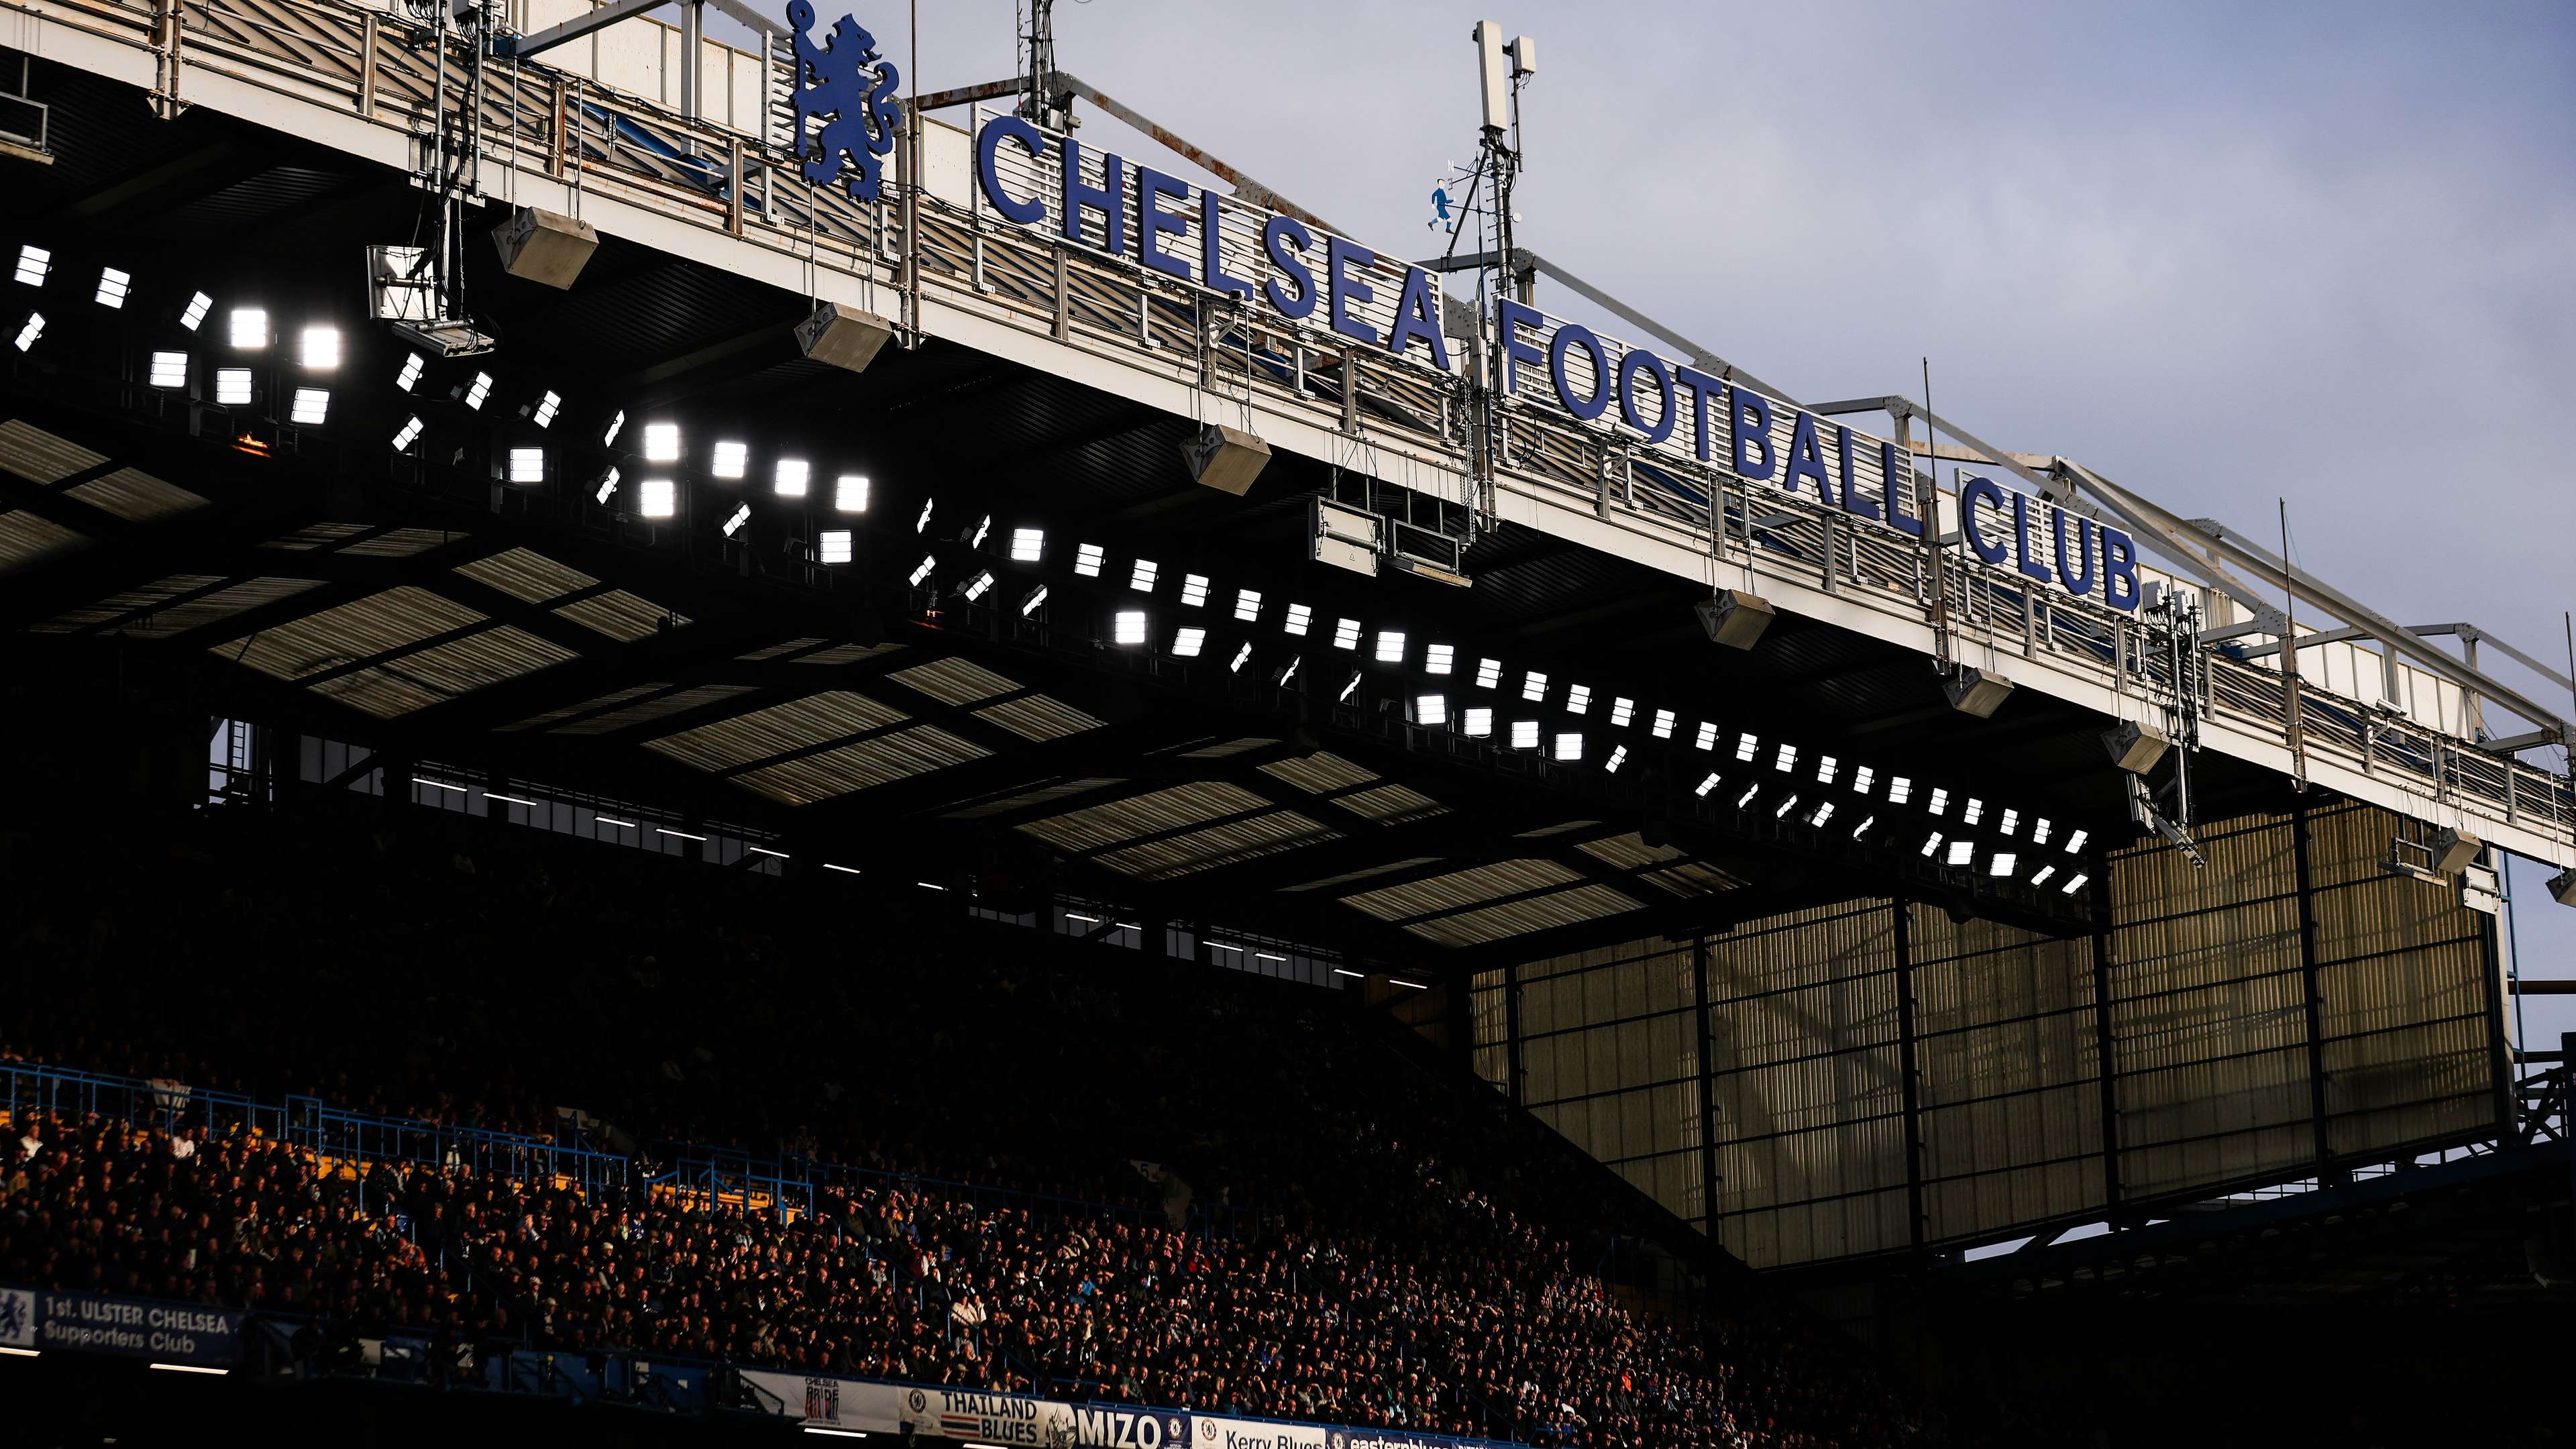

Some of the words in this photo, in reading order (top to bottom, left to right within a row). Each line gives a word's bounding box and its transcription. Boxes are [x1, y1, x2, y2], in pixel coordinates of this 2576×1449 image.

[977, 115, 1450, 370] CHELSEA
[1498, 298, 1924, 537] FOOTBALL
[1962, 476, 2140, 611] CLUB
[46, 1297, 76, 1318] 1st.
[80, 1299, 143, 1325] ULSTER
[148, 1308, 229, 1334] CHELSEA
[44, 1320, 144, 1348] Supporters
[150, 1331, 195, 1354] Club
[806, 1387, 839, 1420] PRIDE
[941, 1391, 1036, 1420] THAILAND
[981, 1419, 1036, 1443] BLUES
[1077, 1408, 1161, 1449] MIZO
[1226, 1430, 1271, 1449] Kerry
[1350, 1436, 1450, 1449] easternbl
